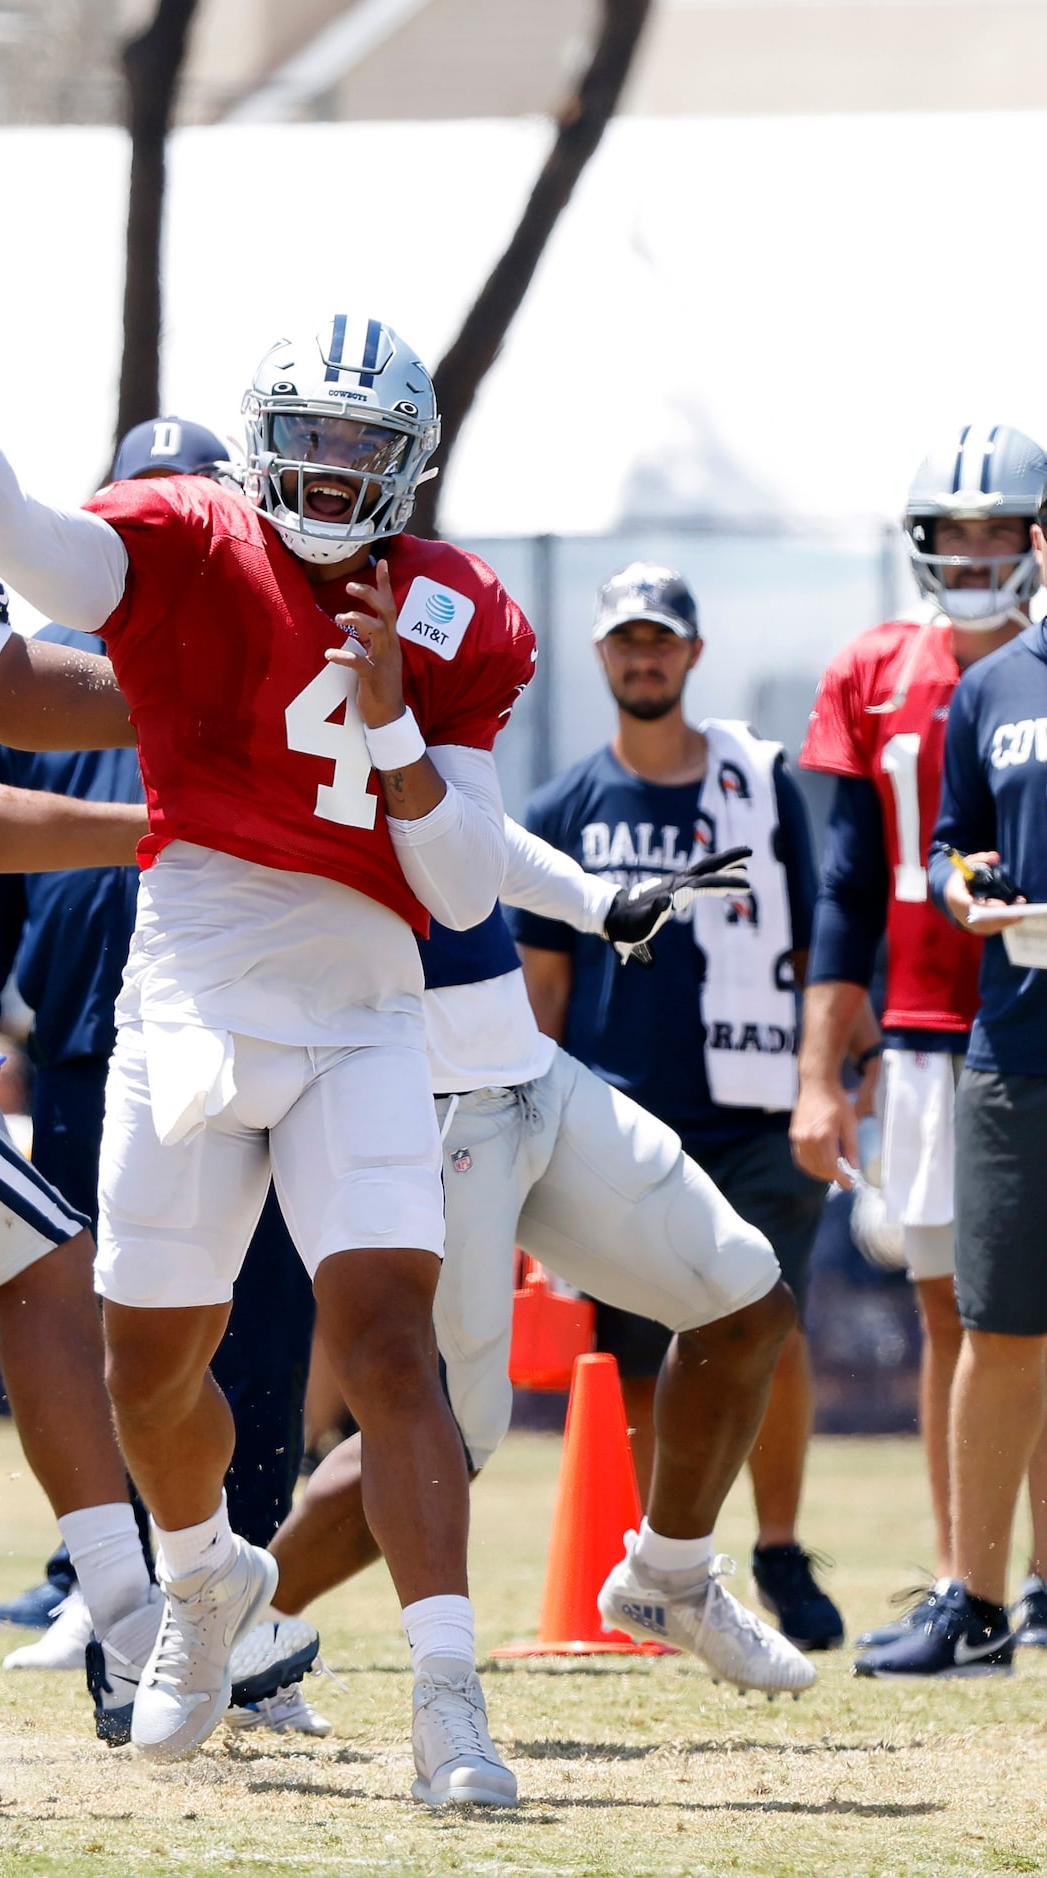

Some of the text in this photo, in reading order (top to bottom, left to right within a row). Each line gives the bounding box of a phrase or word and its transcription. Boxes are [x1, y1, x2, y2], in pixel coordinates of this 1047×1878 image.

[328, 389, 368, 402] COWBOYS
[150, 422, 182, 458] D
[411, 620, 450, 646] AT&T
[284, 635, 378, 831] 4
